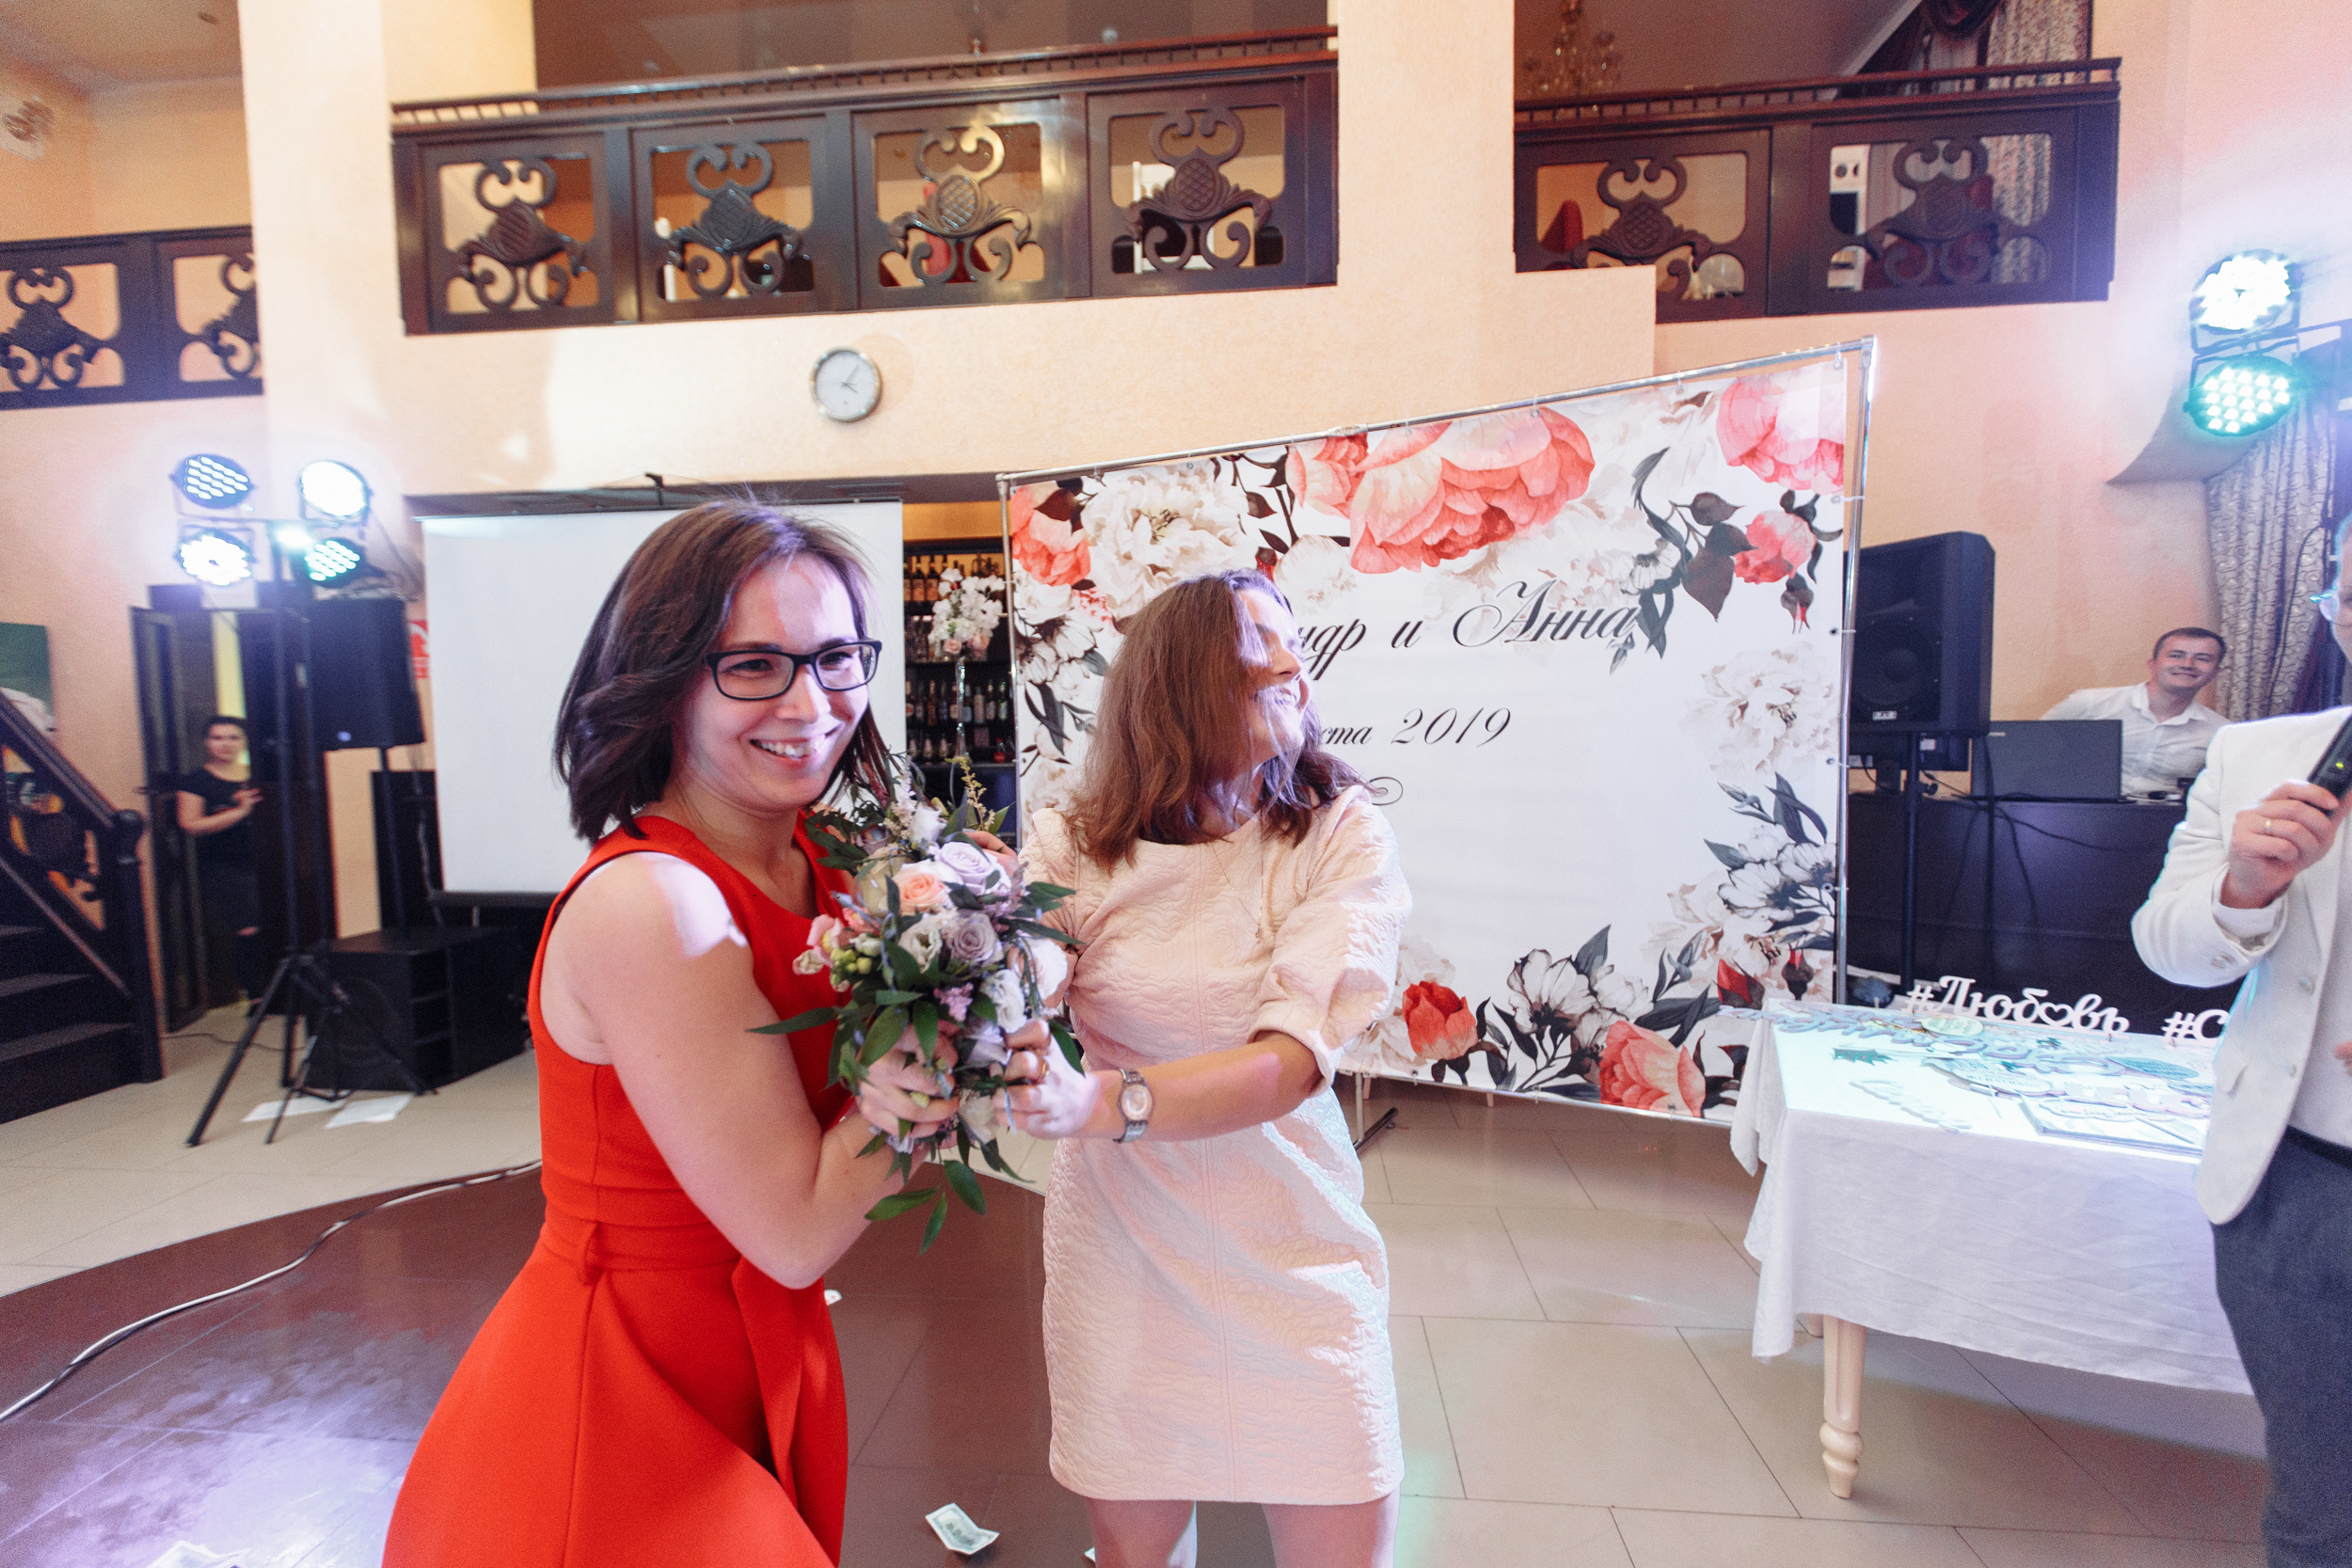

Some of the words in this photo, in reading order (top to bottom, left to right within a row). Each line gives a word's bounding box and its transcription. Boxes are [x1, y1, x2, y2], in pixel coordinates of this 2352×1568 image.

[1391, 619, 1422, 649] и
[1453, 578, 1642, 648] Анна
[1391, 707, 1511, 749] 2019
